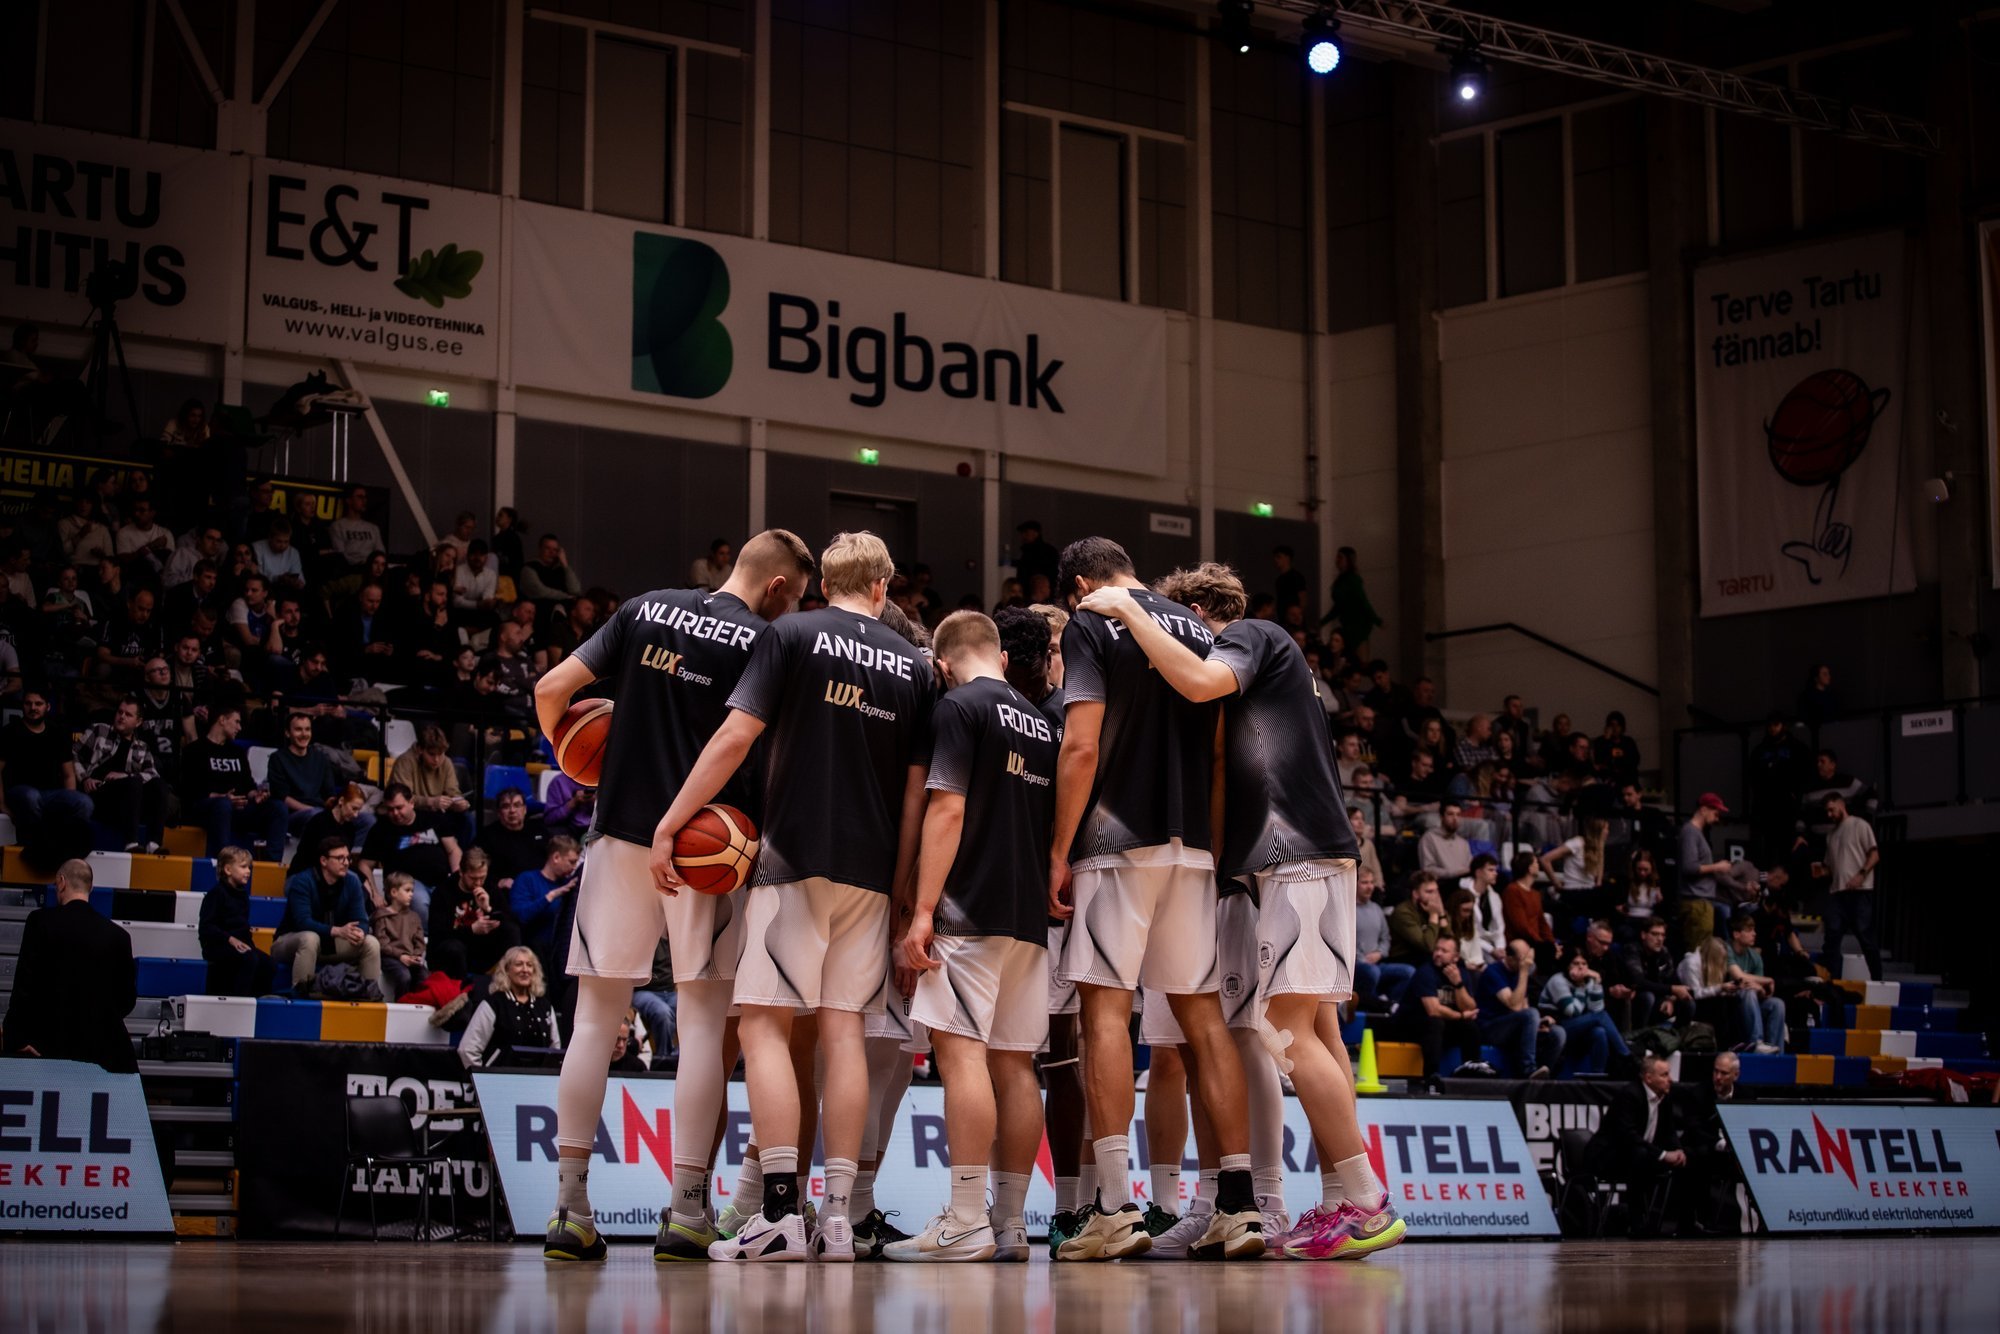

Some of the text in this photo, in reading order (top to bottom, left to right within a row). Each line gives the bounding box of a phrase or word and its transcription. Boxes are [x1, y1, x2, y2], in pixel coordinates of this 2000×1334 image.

[266, 174, 430, 276] E&T
[262, 293, 485, 336] VALGUS-, HELI- ja VIDEOTEHNIKA
[1711, 269, 1881, 325] Terve Tartu
[285, 318, 463, 356] www.valgus.ee
[769, 292, 1065, 413] Bigbank
[1712, 318, 1821, 367] fännab!
[635, 600, 757, 652] NURGER
[640, 643, 713, 686] LUX Express
[812, 631, 914, 682] ANDRE
[824, 679, 897, 722] LUX Express
[996, 703, 1052, 743] ROOS
[156, 736, 173, 754] 2
[208, 756, 242, 773] EESTI
[1023, 770, 1051, 787] Express
[1748, 1109, 1963, 1191] RANTELL
[1403, 1183, 1526, 1201] ELEKTER
[1869, 1181, 1969, 1197] ELEKTER
[1403, 1211, 1529, 1227] elektrilahendused
[1788, 1205, 1974, 1226] Asjatundlikud elektrilahendused
